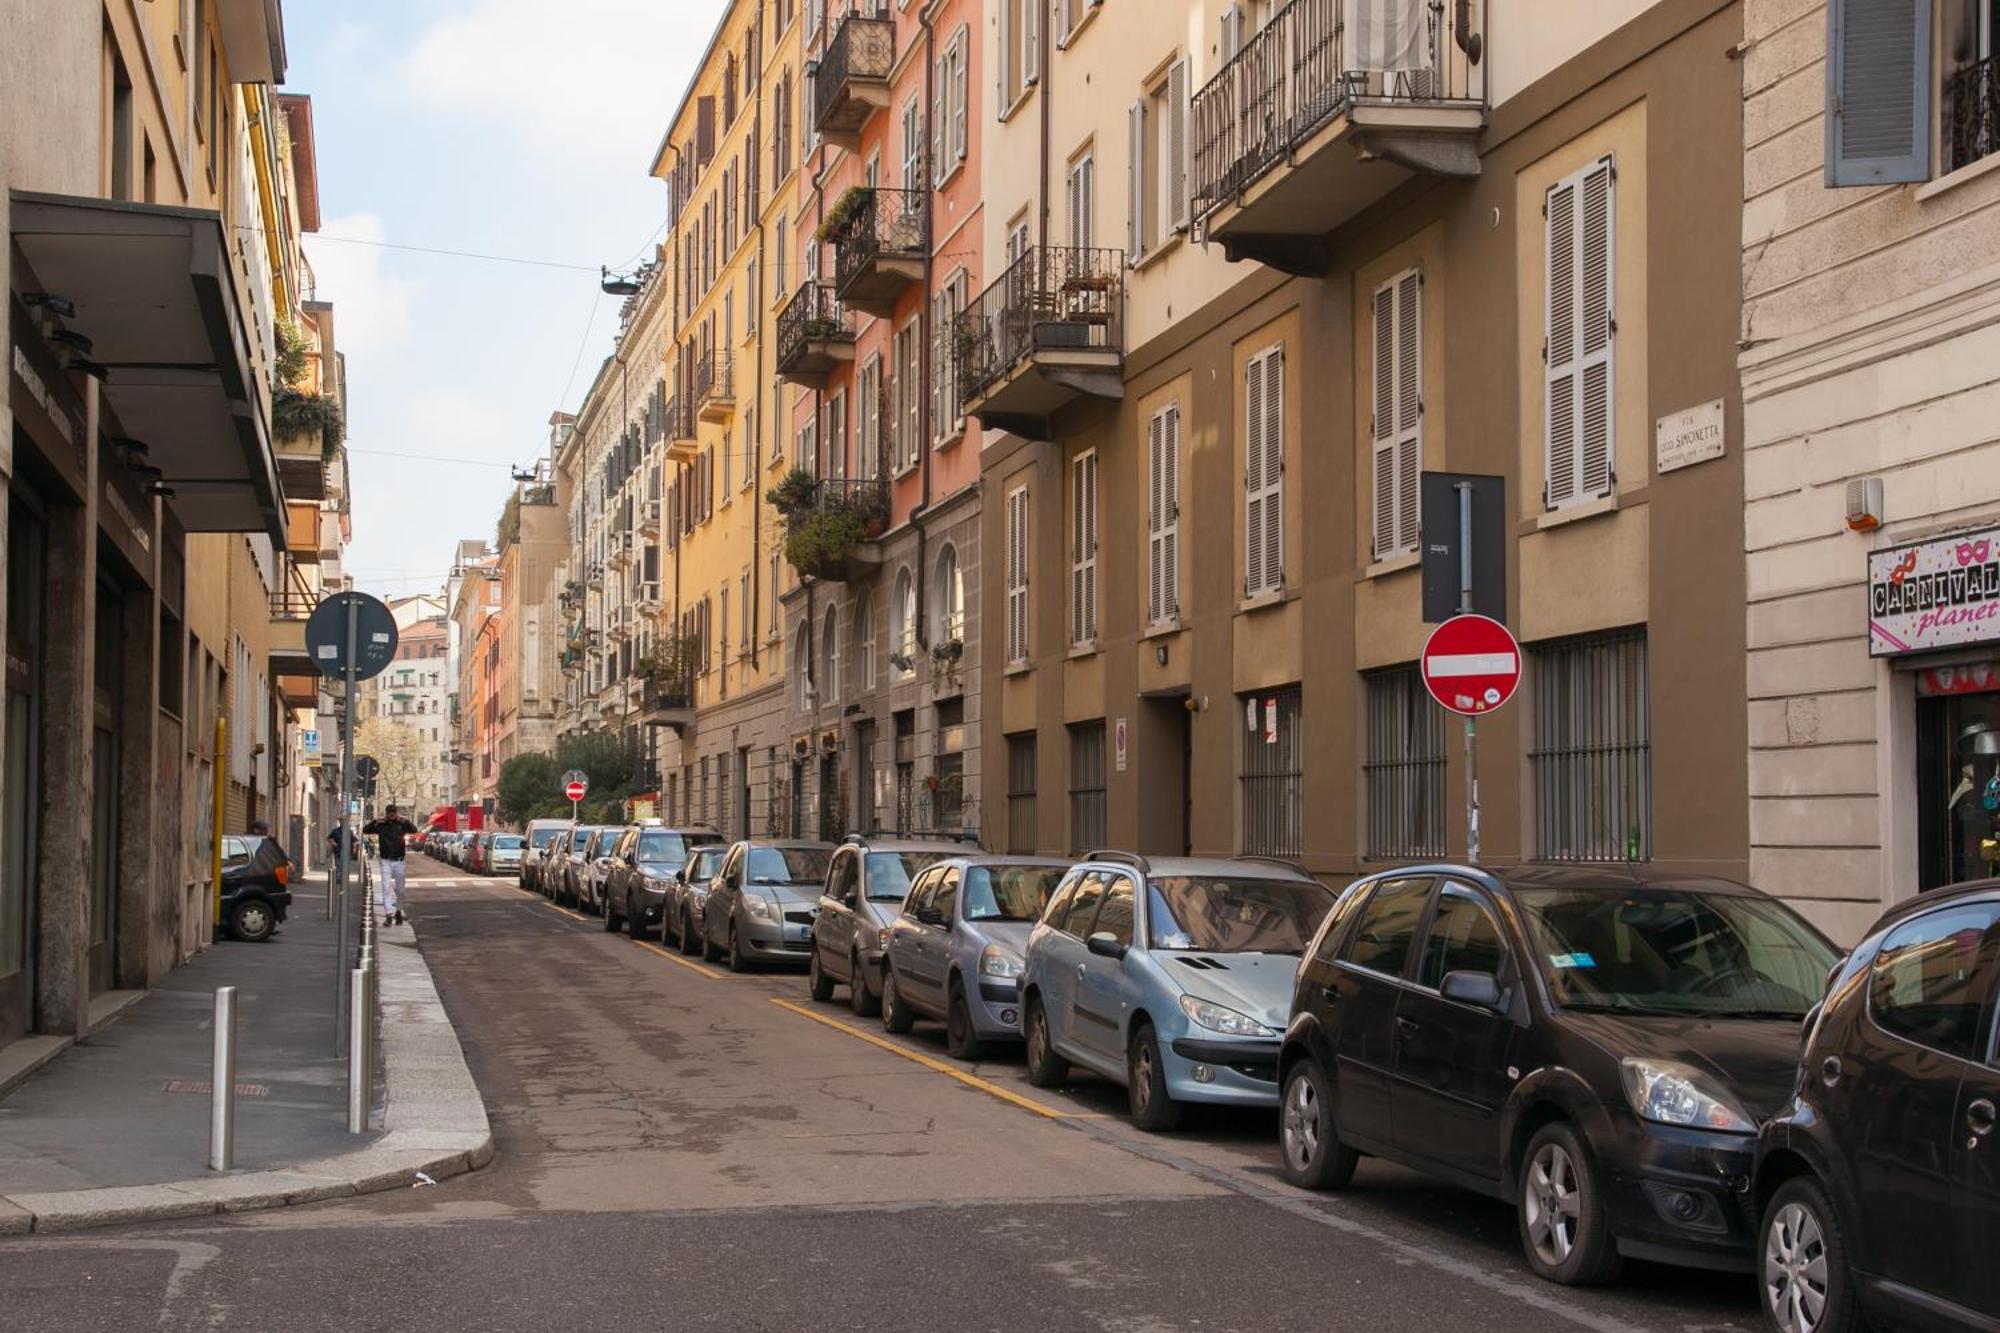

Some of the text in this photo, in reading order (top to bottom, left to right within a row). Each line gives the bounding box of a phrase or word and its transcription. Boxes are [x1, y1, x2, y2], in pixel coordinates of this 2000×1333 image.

[1676, 425, 1719, 448] SIMONETTA
[1682, 416, 1694, 427] VIA
[1874, 564, 1998, 615] CARNIVAL
[1917, 601, 1999, 638] planet
